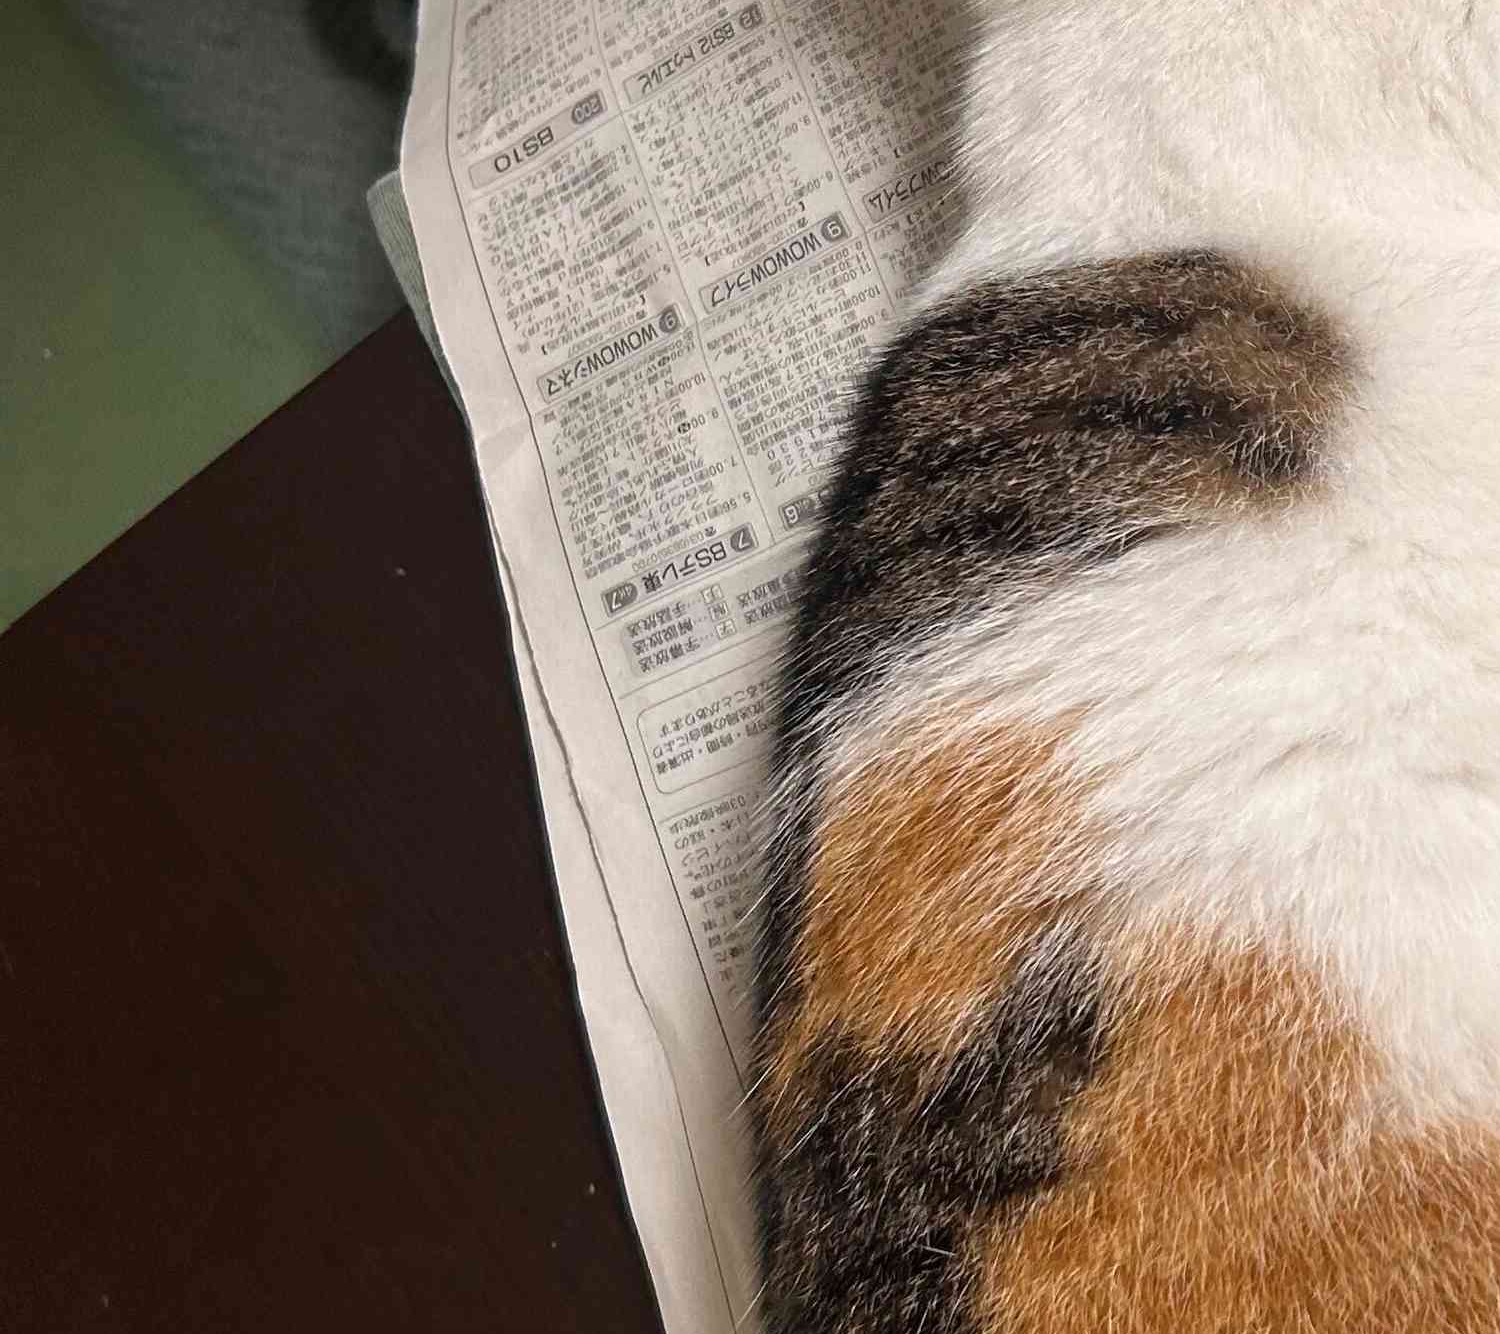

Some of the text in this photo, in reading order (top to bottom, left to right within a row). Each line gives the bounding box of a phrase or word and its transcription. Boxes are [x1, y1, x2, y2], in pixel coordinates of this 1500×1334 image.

[492, 125, 554, 173] BS10
[706, 230, 821, 306] WOWOWライブ
[542, 321, 658, 396] WOWOWシネマ
[639, 539, 728, 593] BSテレ東
